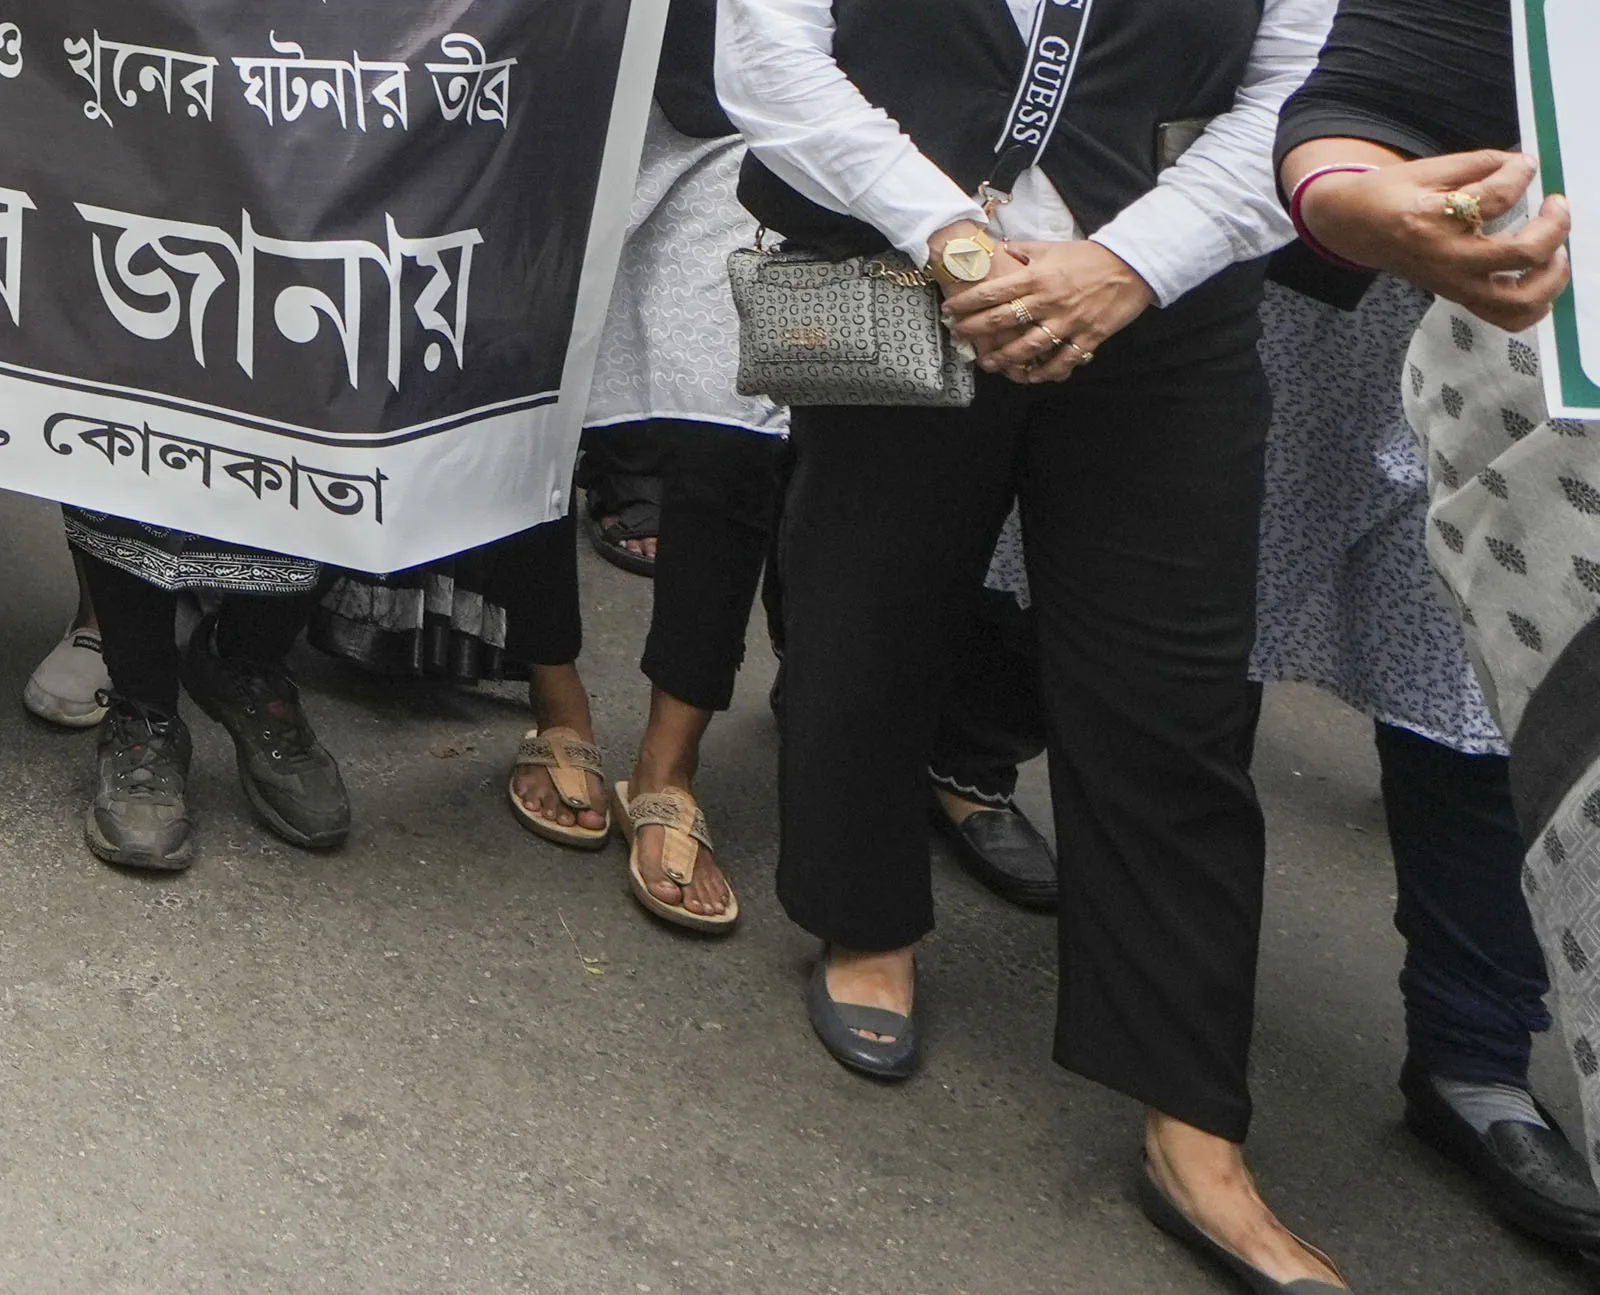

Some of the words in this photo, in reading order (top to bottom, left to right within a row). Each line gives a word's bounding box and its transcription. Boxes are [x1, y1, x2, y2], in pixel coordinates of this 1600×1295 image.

[63, 28, 220, 128] খুনের
[230, 29, 411, 133] ঘটনার
[425, 32, 518, 130] তীব্র
[1012, 36, 1070, 145] GUESS
[74, 208, 485, 393] জানায়
[43, 412, 389, 524] কোলকাতা
